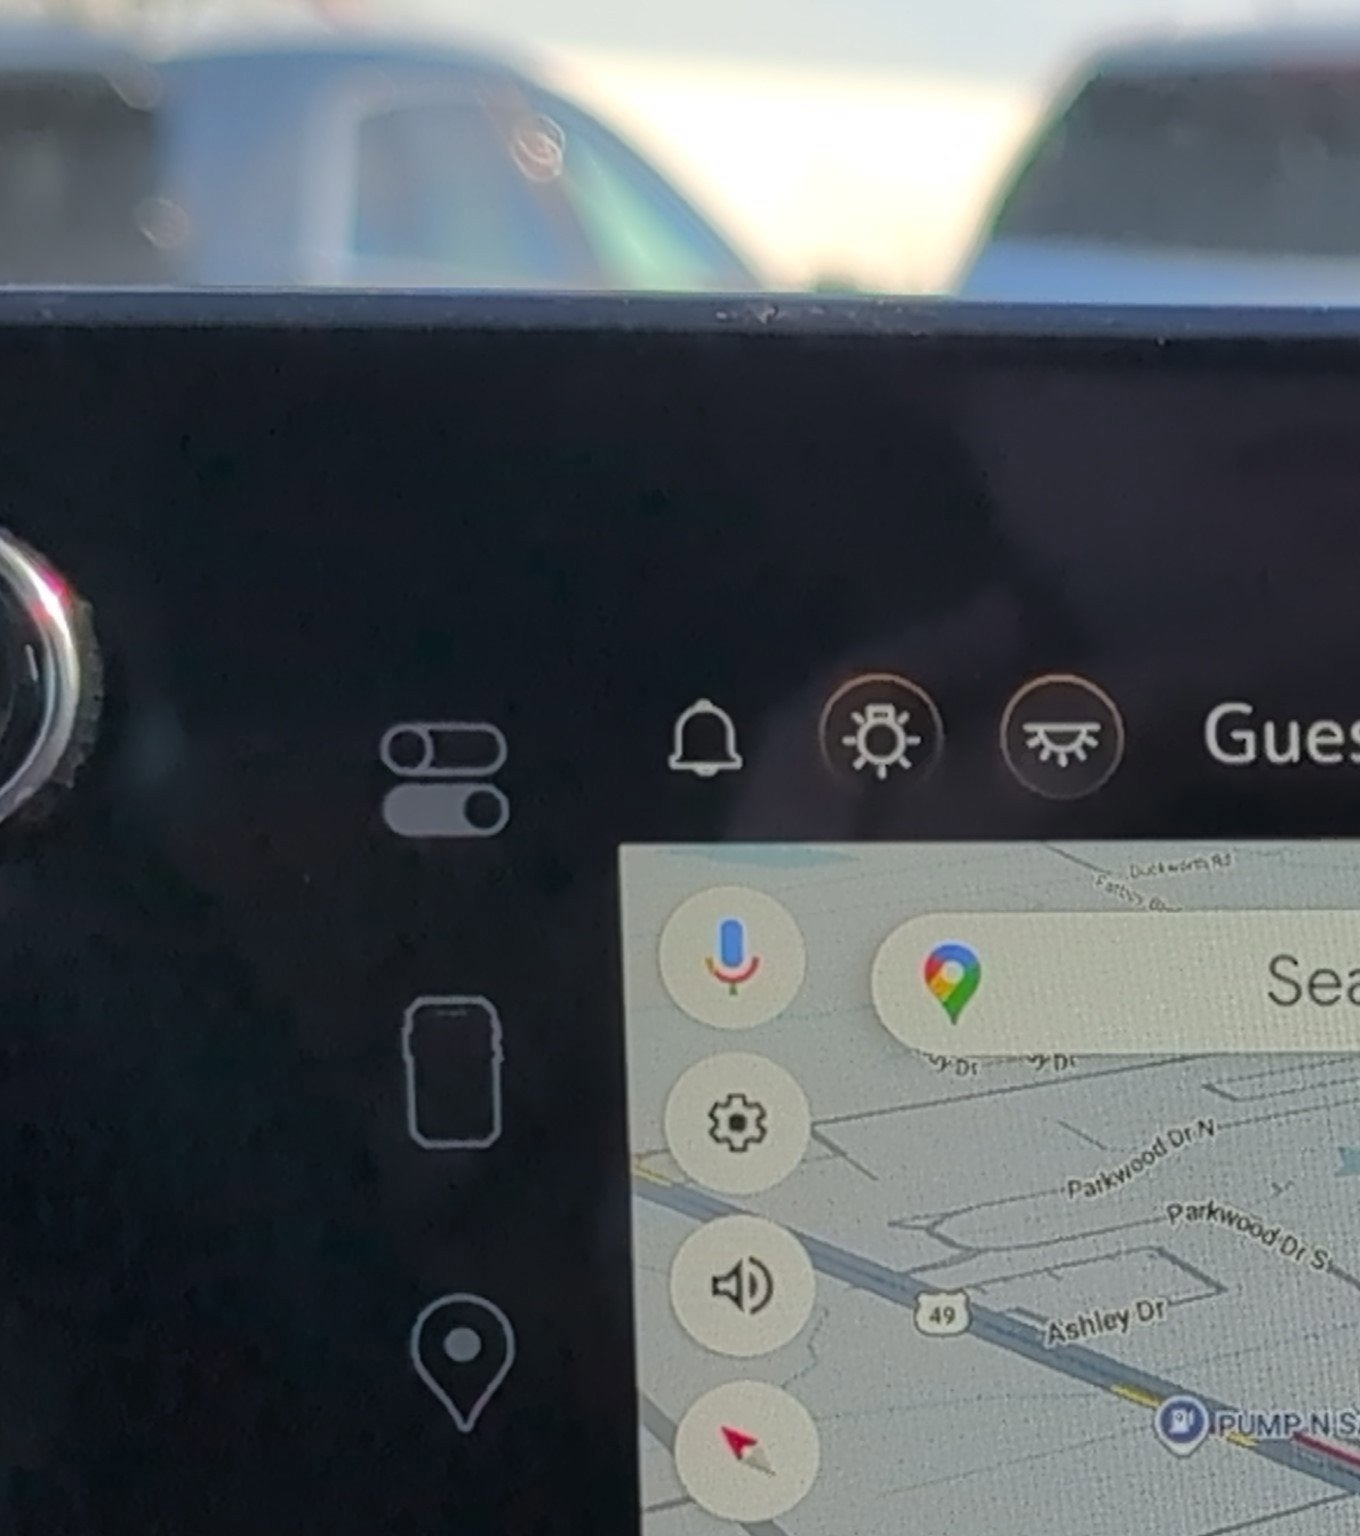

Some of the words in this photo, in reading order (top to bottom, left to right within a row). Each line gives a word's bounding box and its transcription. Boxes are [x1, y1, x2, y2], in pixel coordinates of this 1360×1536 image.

[1067, 1136, 1167, 1200] Parkwood
[1167, 1120, 1196, 1151] Dr
[1199, 1117, 1217, 1139] N
[1166, 1198, 1281, 1251] Parkwood
[1280, 1234, 1308, 1264] Dr
[1309, 1245, 1330, 1270] S
[926, 1304, 957, 1325] 49
[1052, 1308, 1133, 1348] Ashley
[1136, 1298, 1170, 1328] Dr
[1216, 1410, 1302, 1438] PUMP
[1310, 1410, 1332, 1435] N
